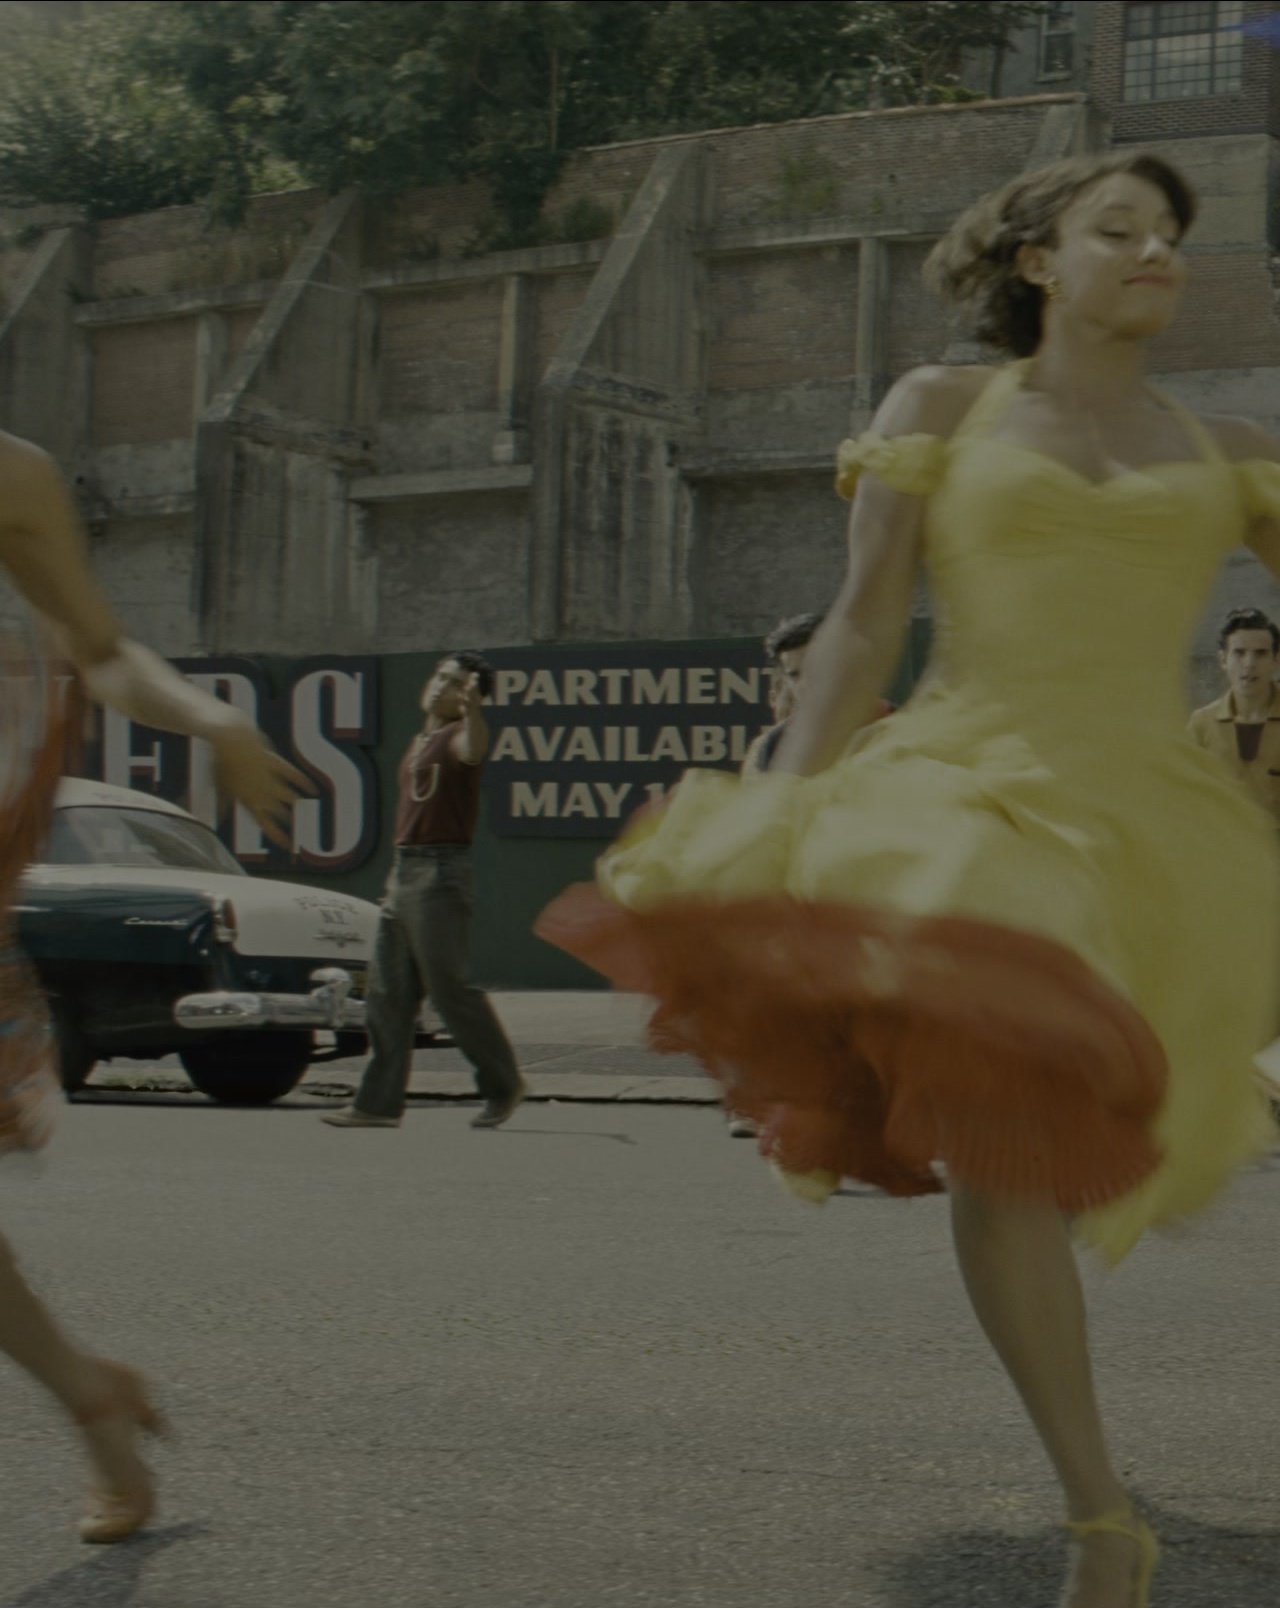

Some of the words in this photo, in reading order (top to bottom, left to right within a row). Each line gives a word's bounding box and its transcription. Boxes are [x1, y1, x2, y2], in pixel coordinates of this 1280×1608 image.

[480, 668, 775, 705] PARTMEN
[491, 725, 774, 762] AVAILABL
[510, 782, 632, 818] MAY
